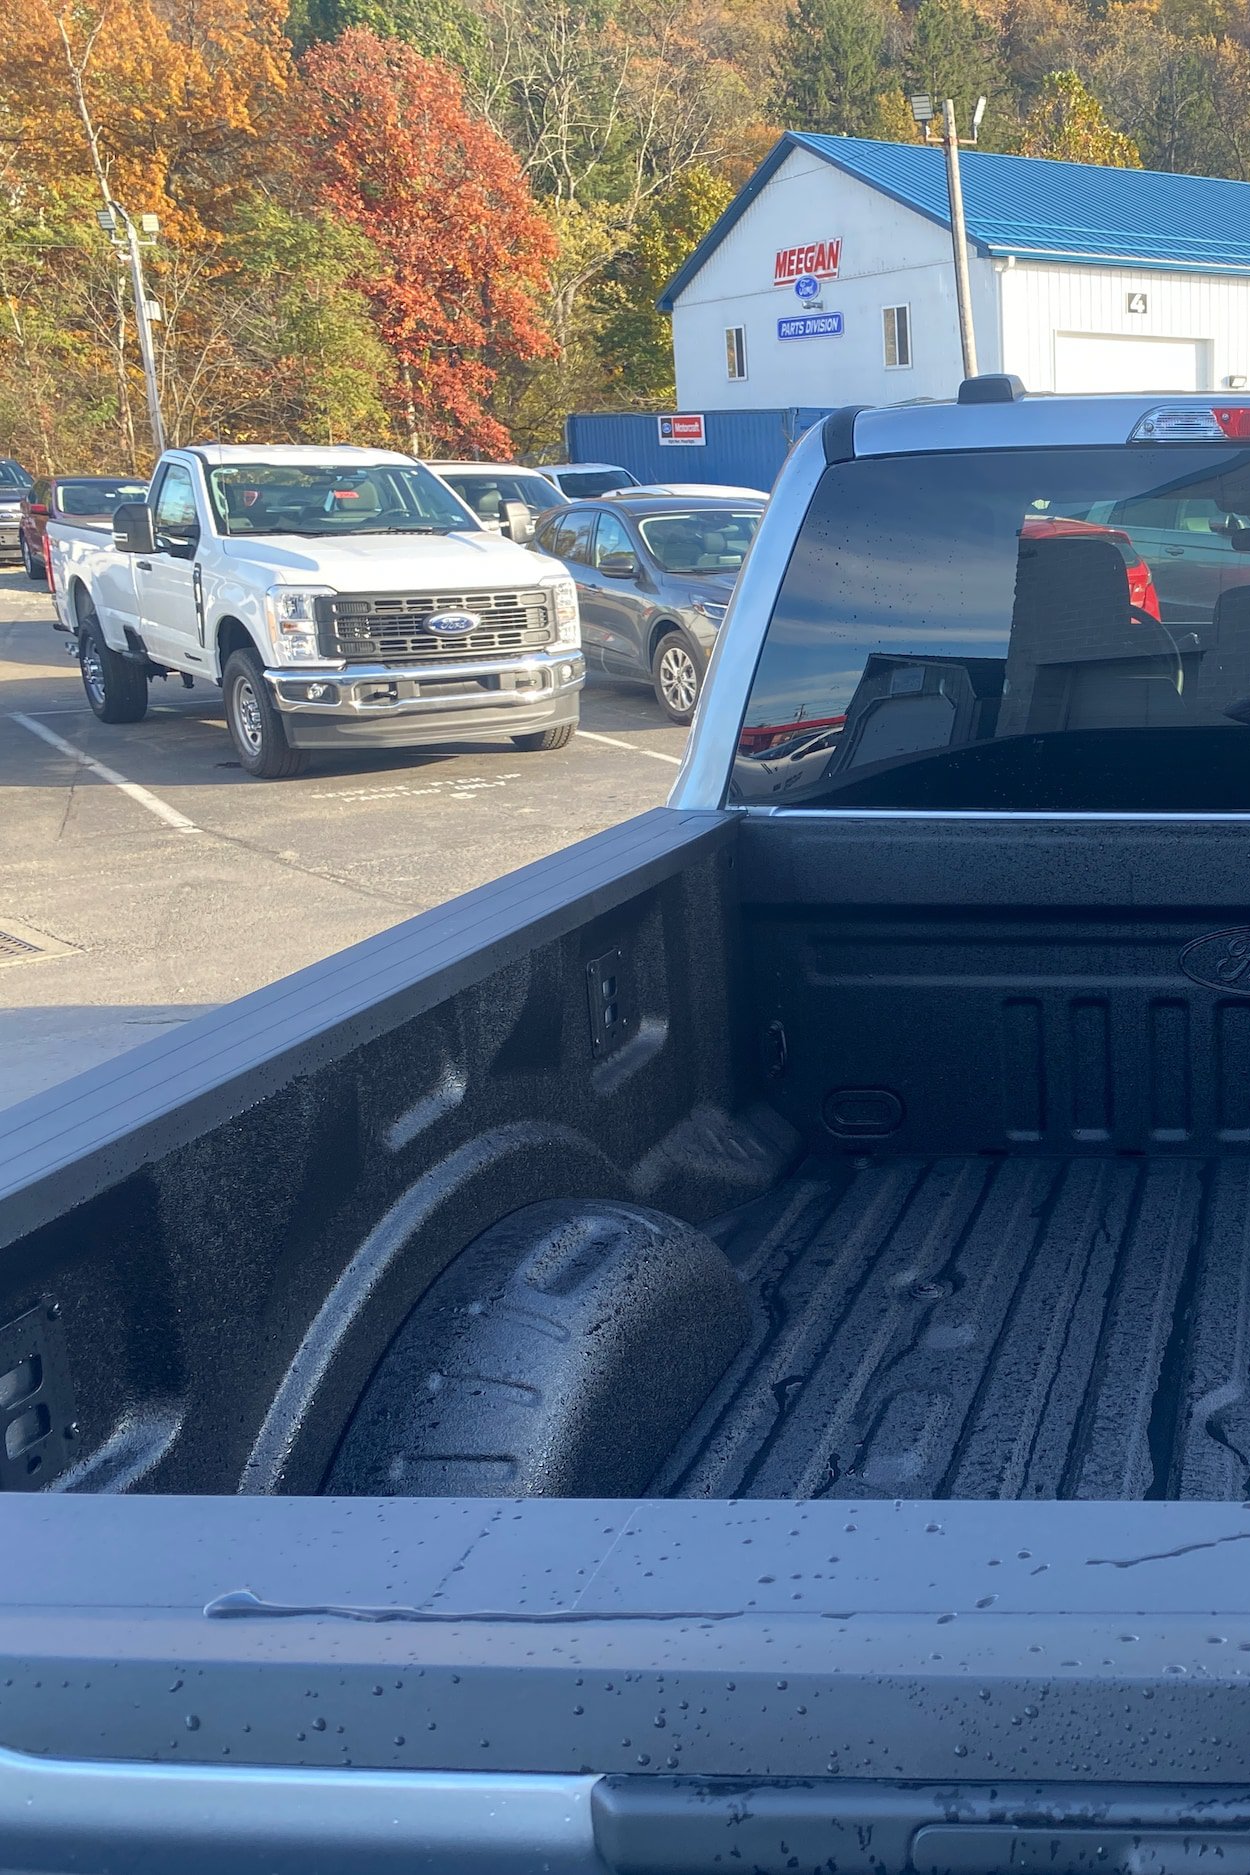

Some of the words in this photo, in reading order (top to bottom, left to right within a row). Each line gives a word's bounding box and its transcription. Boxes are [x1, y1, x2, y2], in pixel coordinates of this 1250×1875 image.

[774, 240, 840, 279] MEEGAN
[1130, 293, 1146, 313] 4
[781, 321, 805, 337] PARTS
[805, 317, 839, 334] DIVISION
